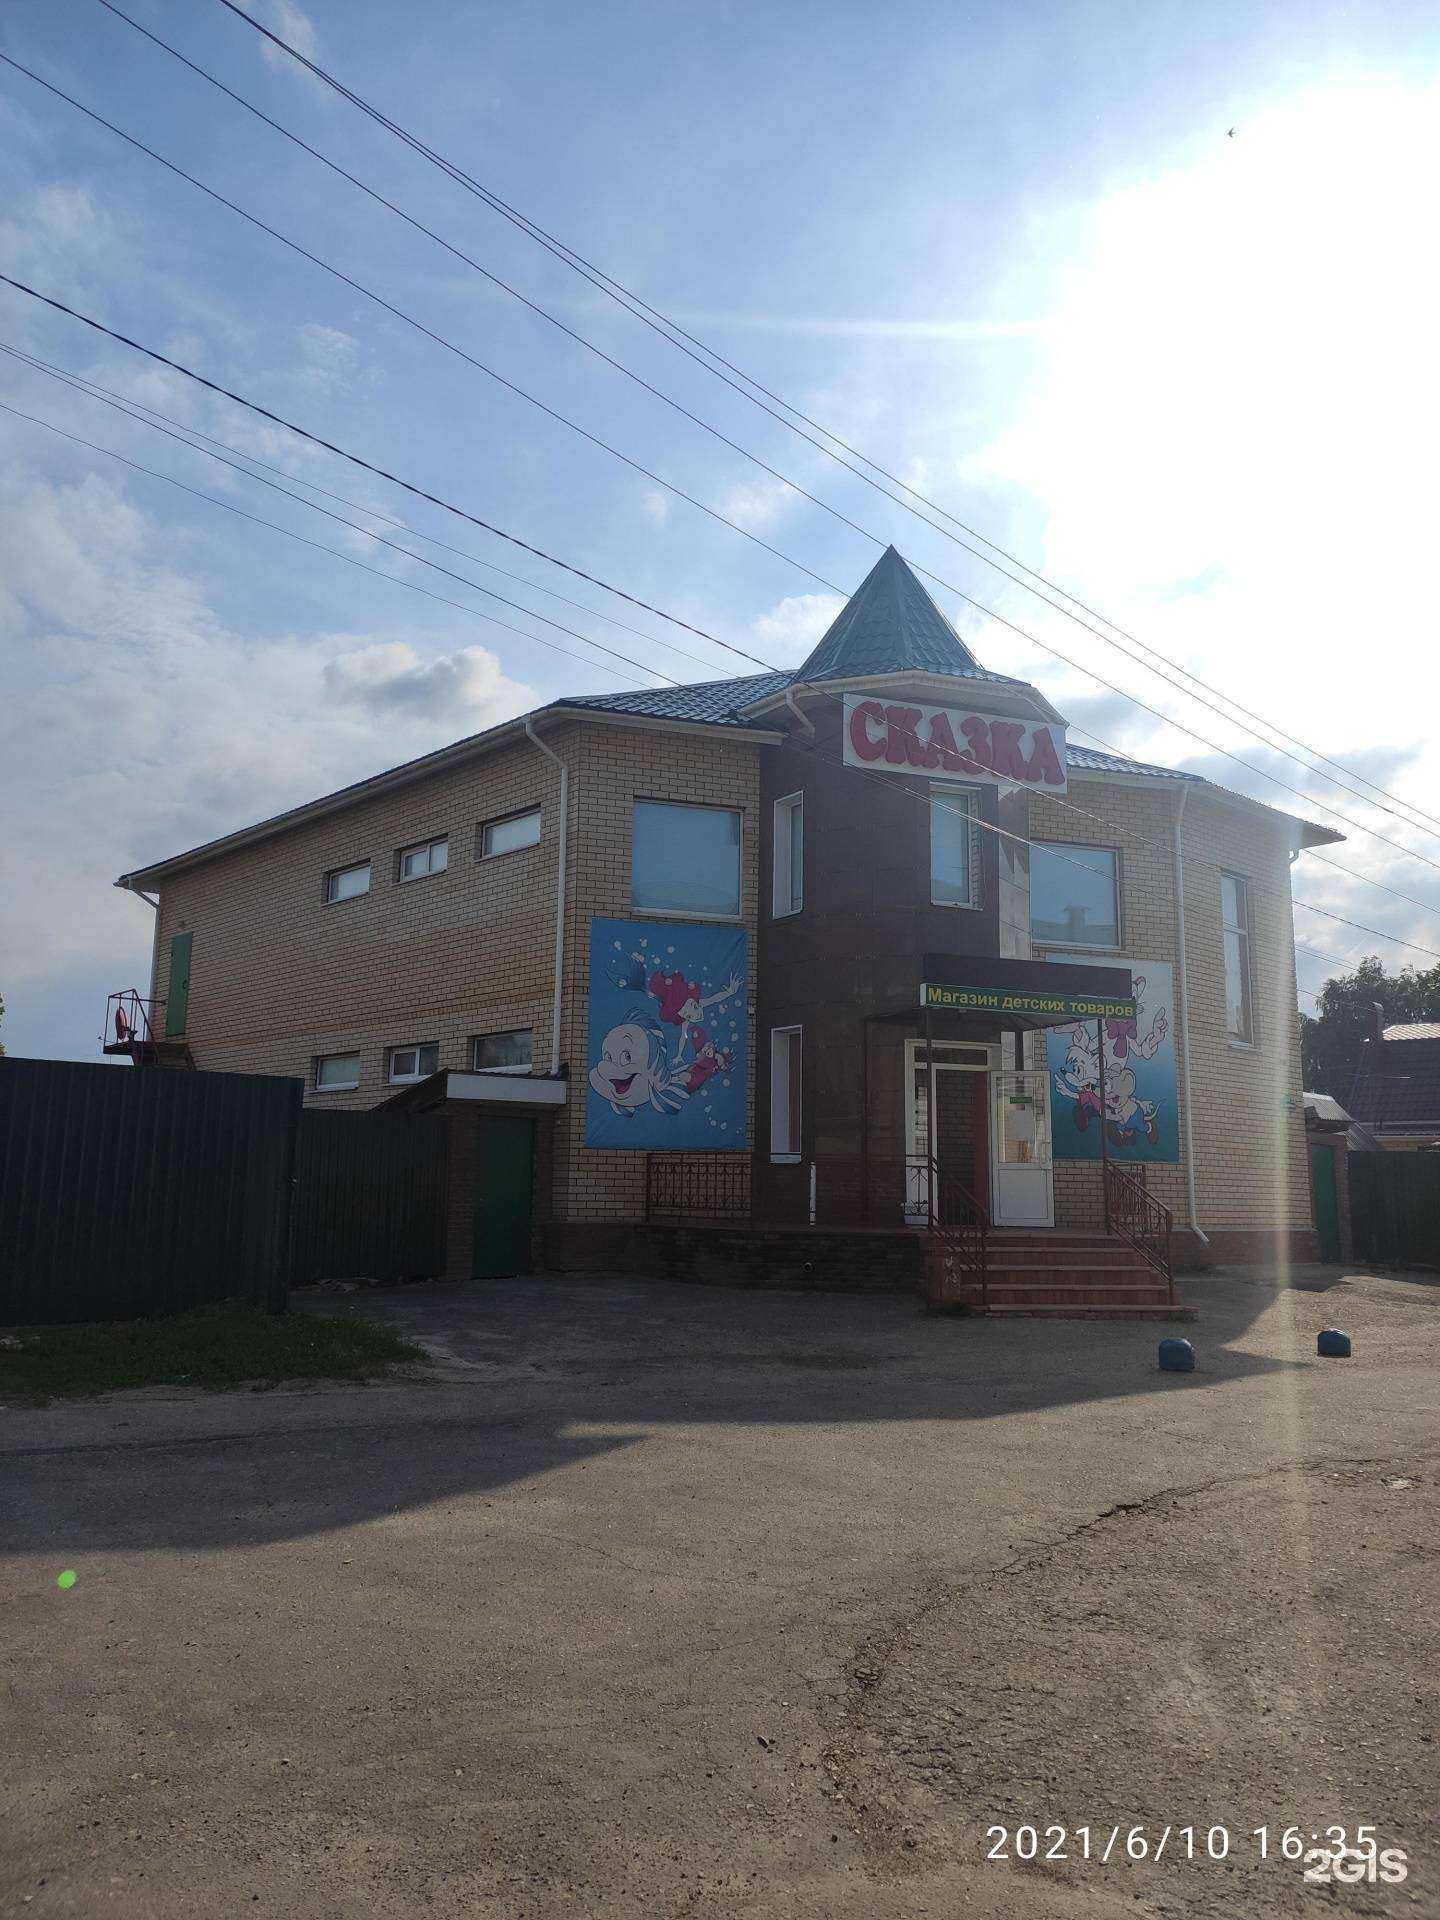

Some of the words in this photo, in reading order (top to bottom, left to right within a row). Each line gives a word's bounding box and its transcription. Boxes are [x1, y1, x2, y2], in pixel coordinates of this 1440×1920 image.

[850, 700, 1066, 786] СКАЗКА
[928, 987, 998, 1007] Магазин
[1001, 998, 1065, 1013] детских
[1070, 1001, 1134, 1018] товаров
